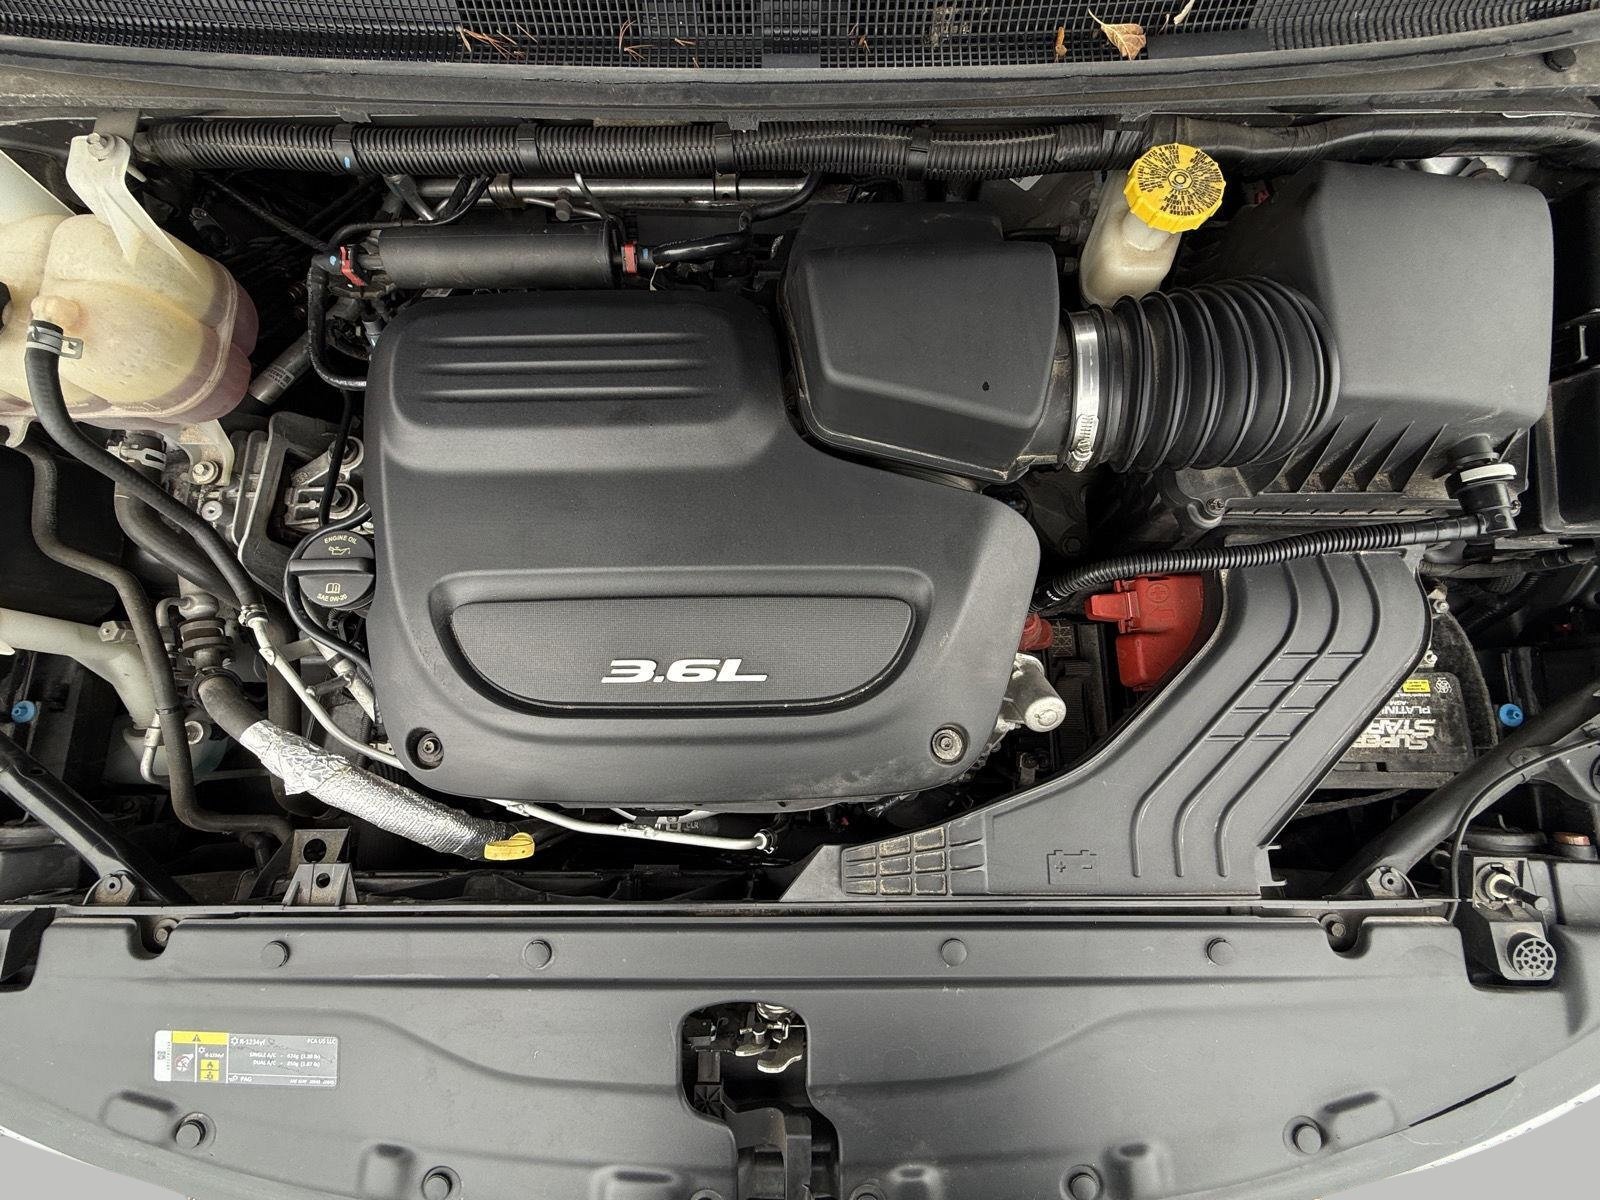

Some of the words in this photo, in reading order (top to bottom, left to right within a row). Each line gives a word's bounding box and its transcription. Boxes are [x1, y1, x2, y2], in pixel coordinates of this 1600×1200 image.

[324, 535, 347, 544] ENGINE
[348, 536, 358, 544] OIL
[316, 593, 329, 602] SAE
[601, 658, 768, 683] 3.6L
[1368, 719, 1436, 738] STAR
